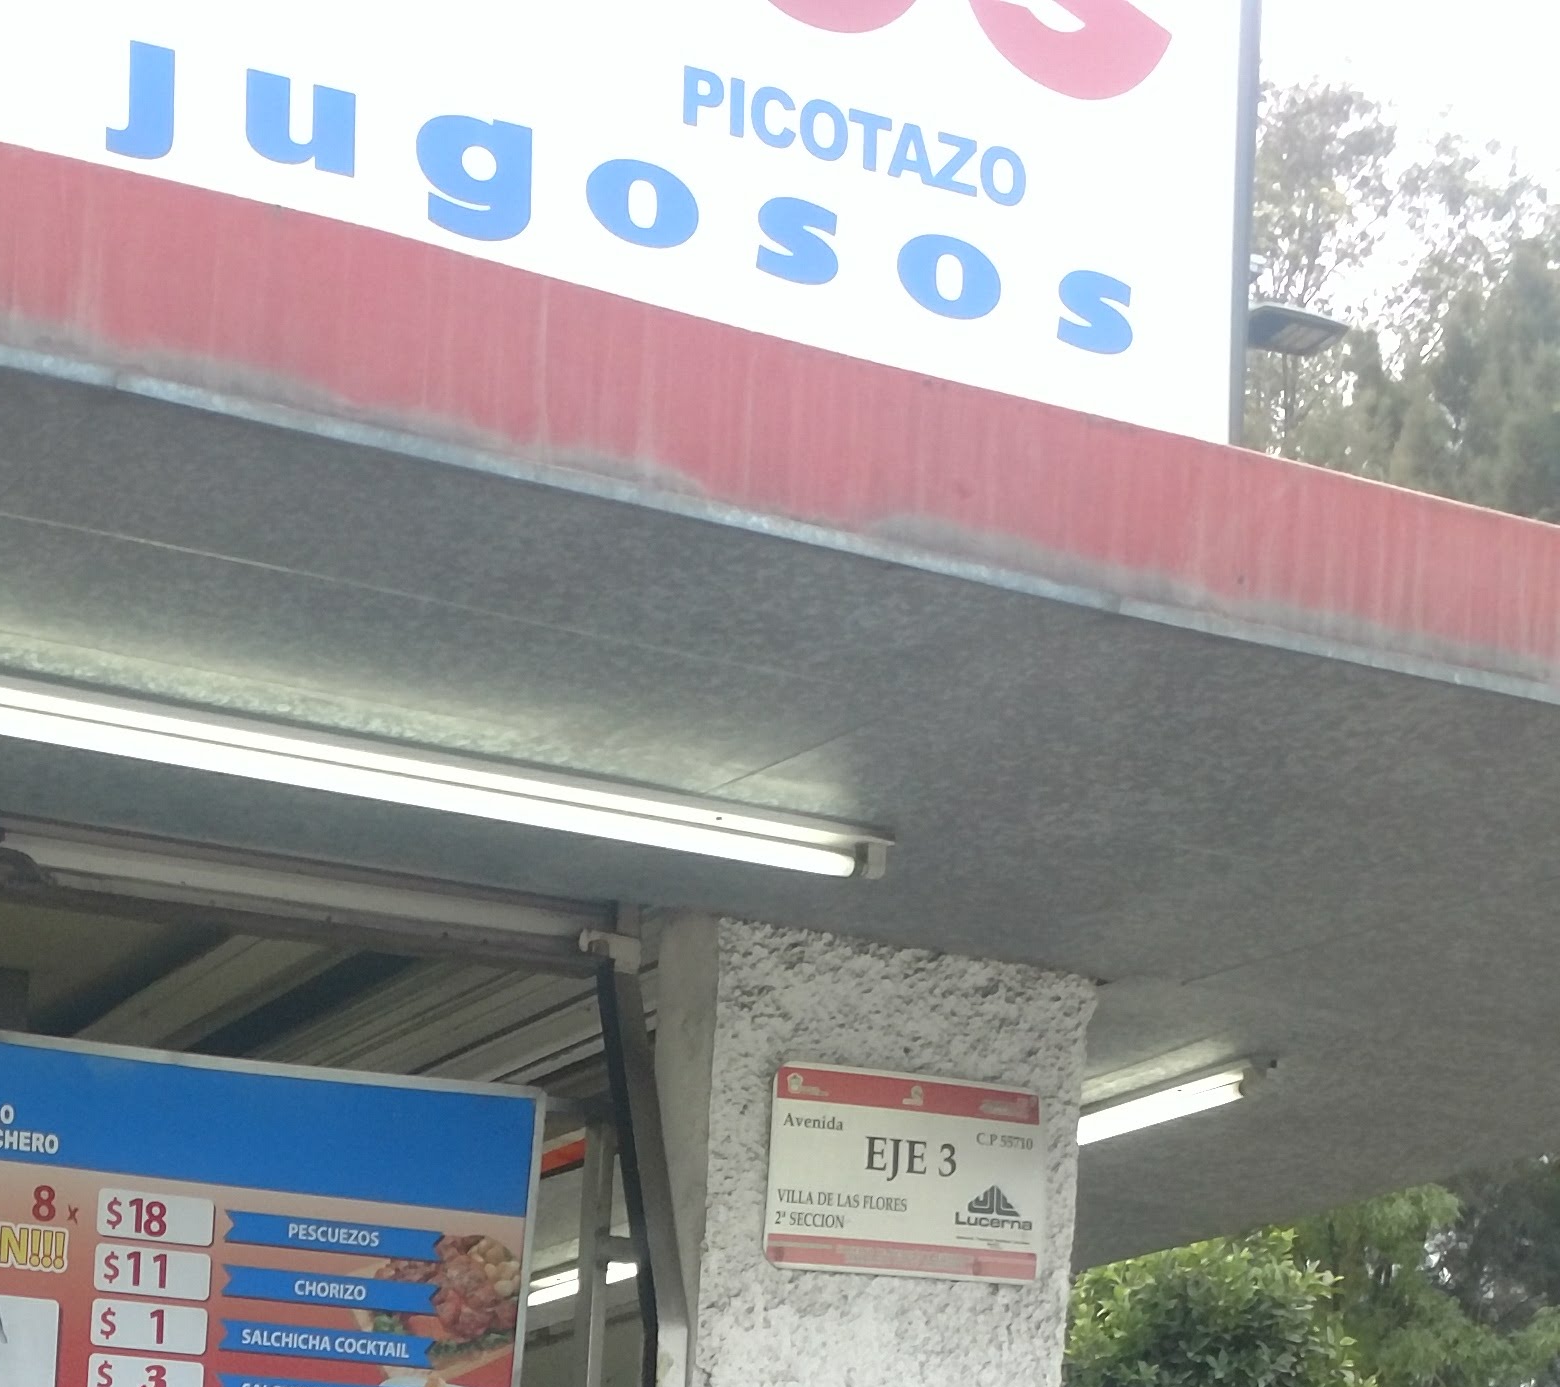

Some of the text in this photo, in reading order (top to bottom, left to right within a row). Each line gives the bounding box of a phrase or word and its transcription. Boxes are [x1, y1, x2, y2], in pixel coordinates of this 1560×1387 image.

[682, 64, 1028, 207] PICOTAZO
[783, 1112, 844, 1131] Avenida
[865, 1136, 958, 1182] EJE 3
[31, 1184, 57, 1223] 8
[777, 1188, 908, 1212] VILLA DE LAS FLORES
[789, 1211, 846, 1229] SECCION
[954, 1211, 1033, 1231] Lucerna
[288, 1223, 380, 1248] PESCUEZOS
[294, 1280, 367, 1301] CHORIZO
[241, 1329, 410, 1359] SALCHICHA COCKTAIL
